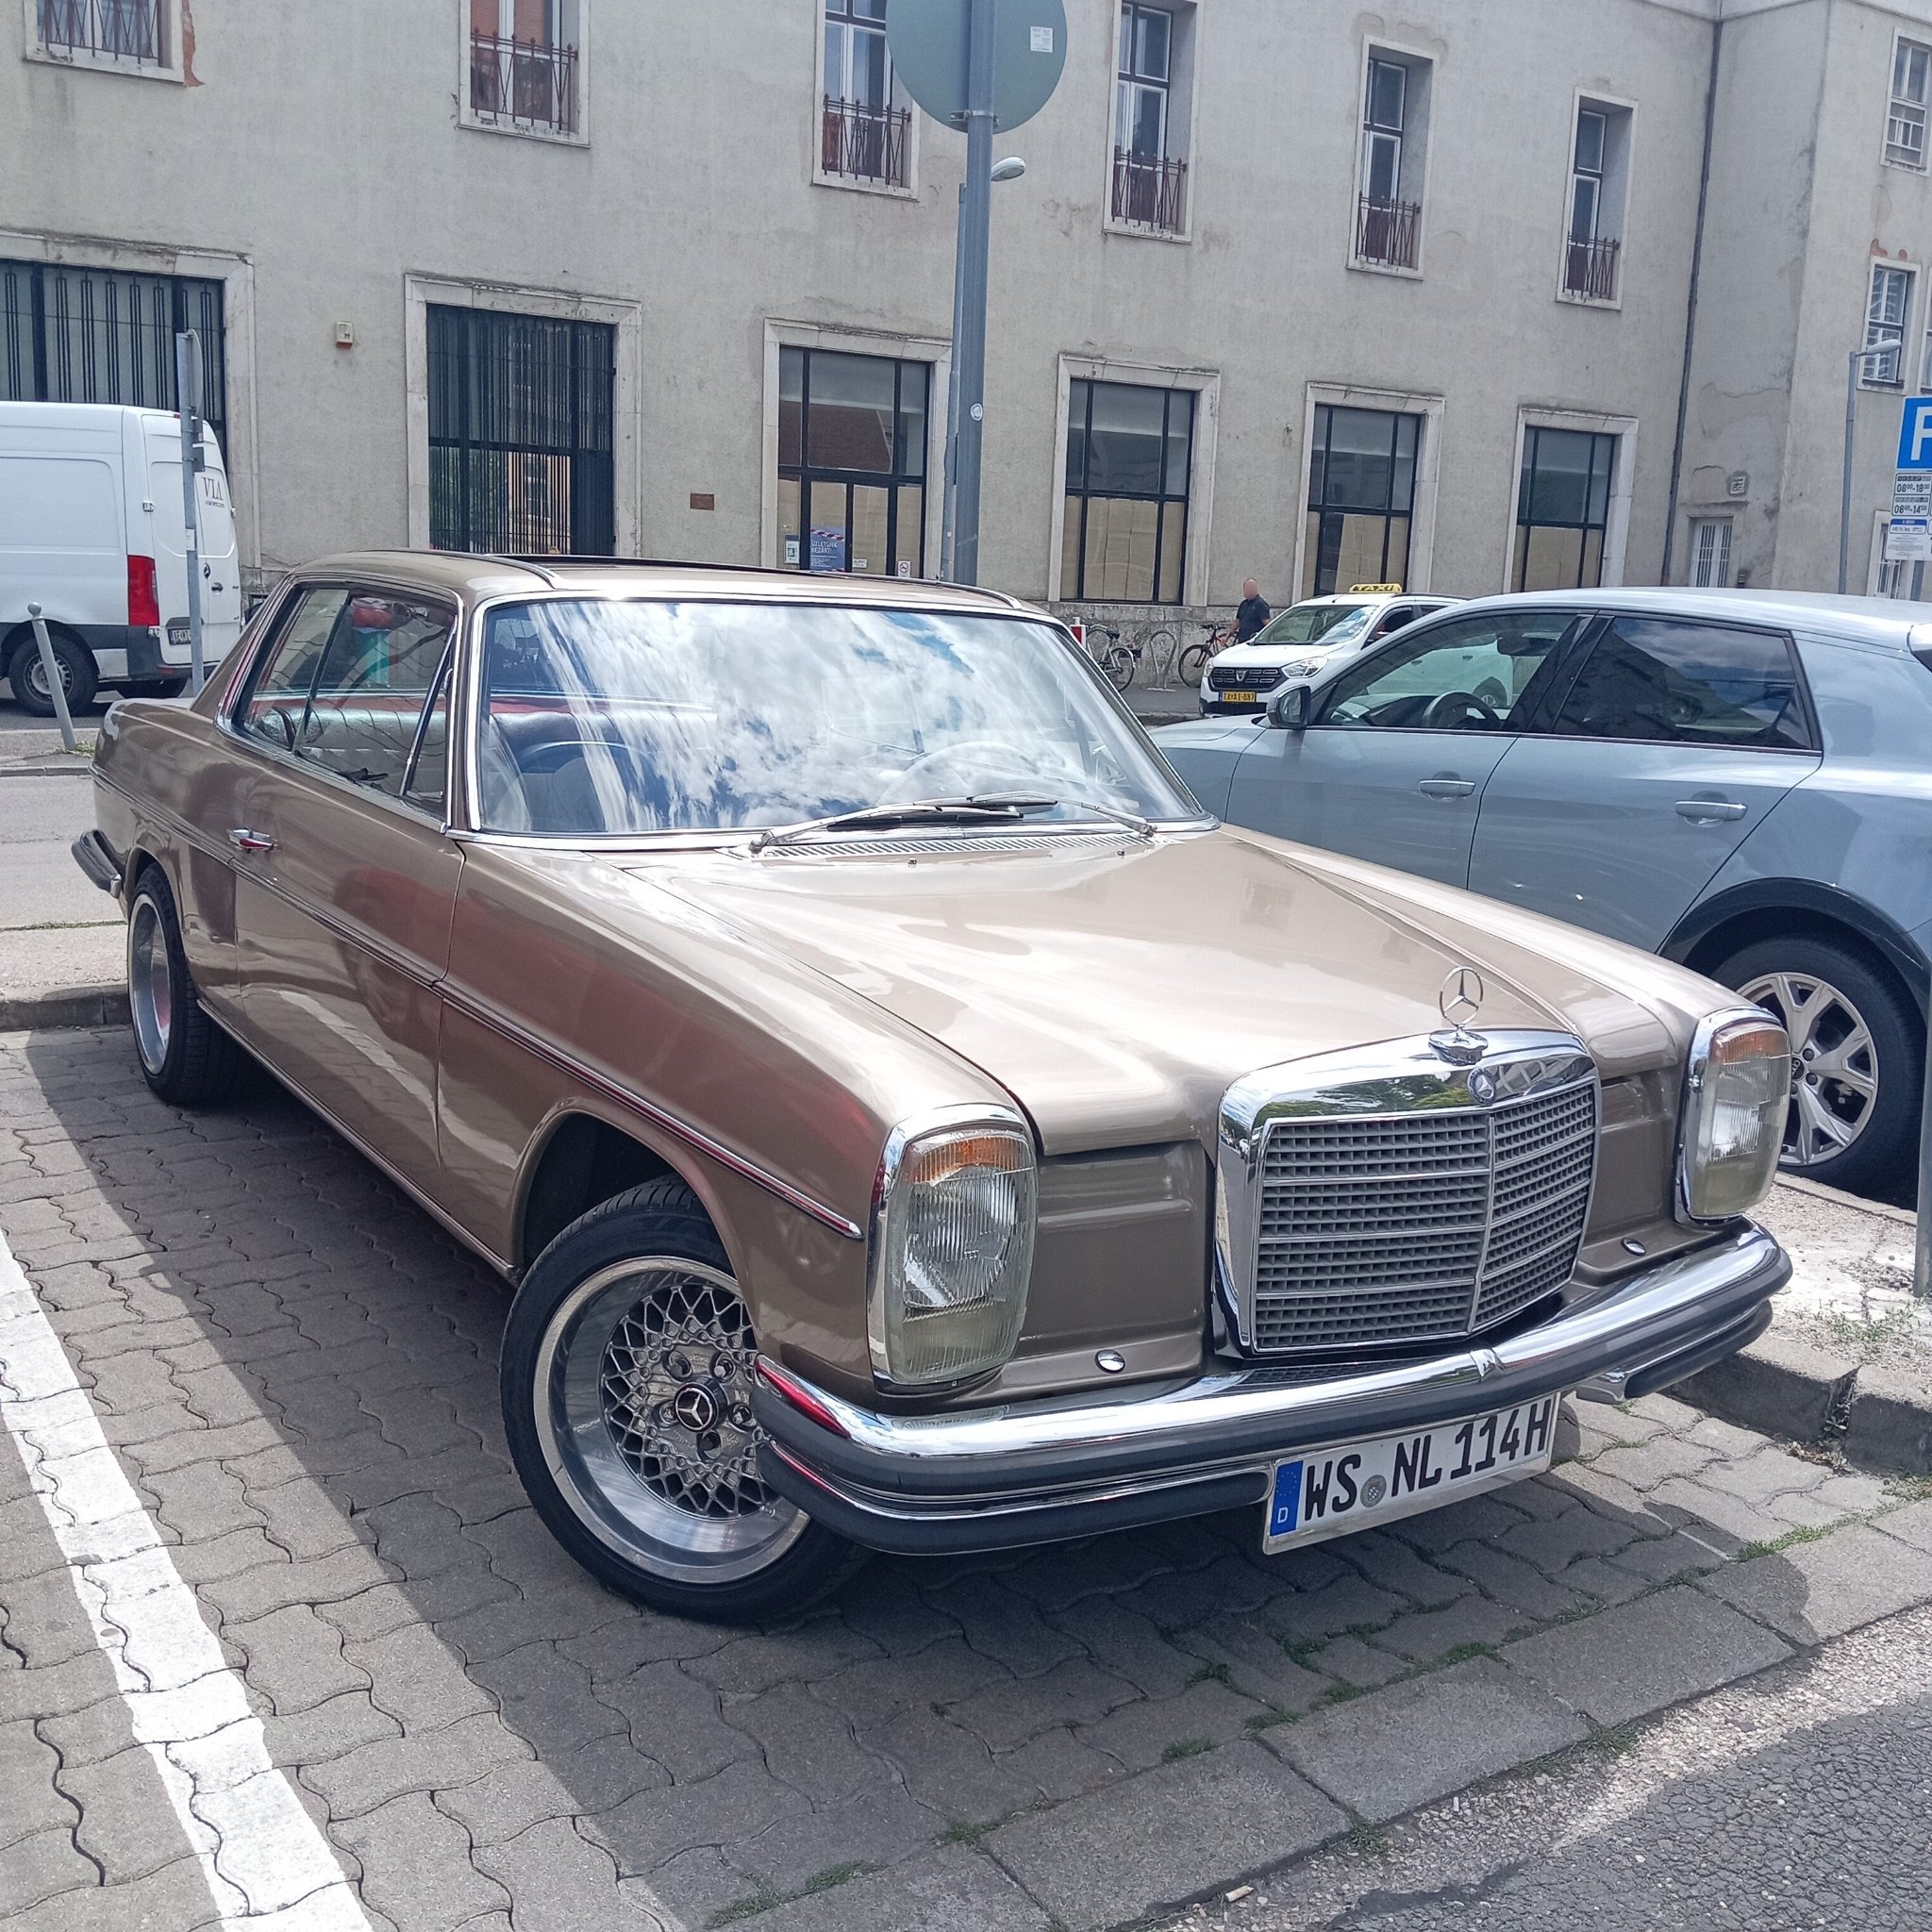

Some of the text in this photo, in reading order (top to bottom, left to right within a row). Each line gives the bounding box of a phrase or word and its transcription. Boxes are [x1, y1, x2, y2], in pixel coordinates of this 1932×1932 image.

[1305, 1399, 1551, 1521] WS NL 114H
[1277, 1507, 1289, 1524] D
